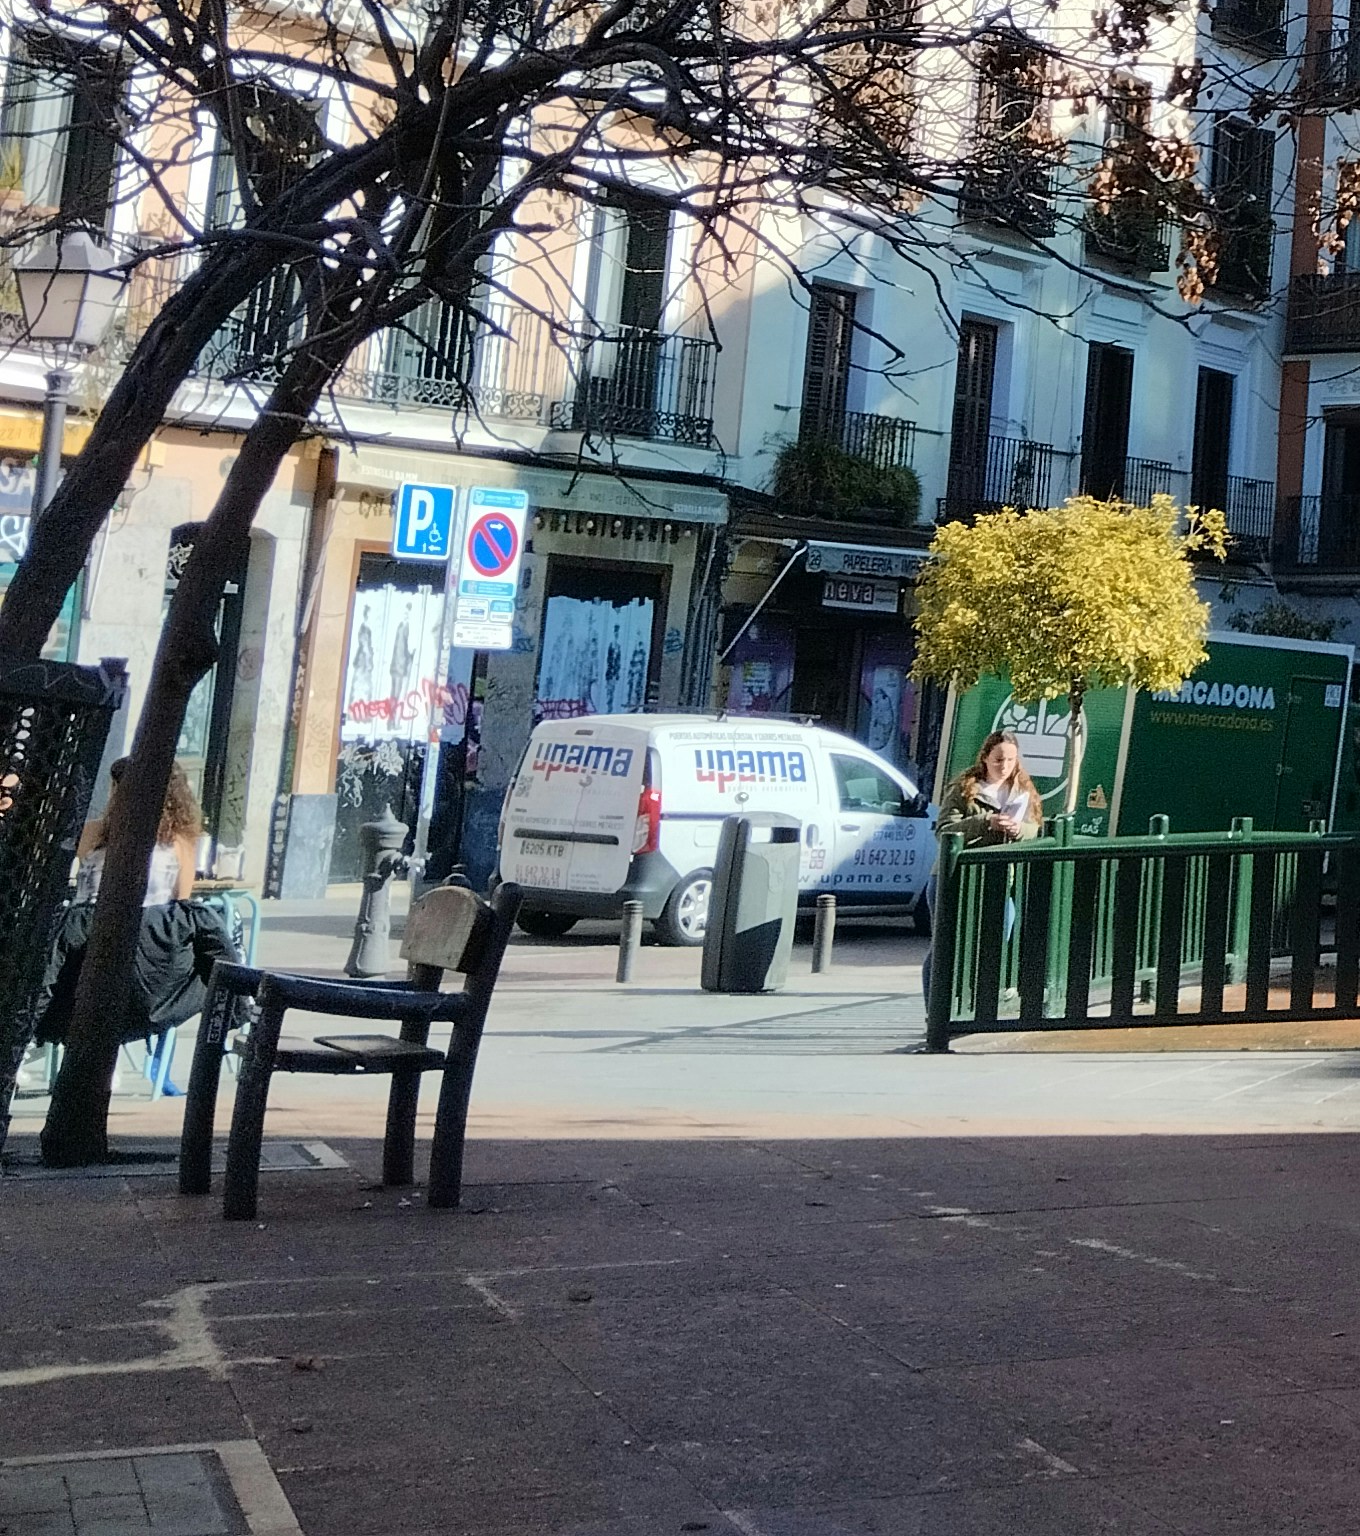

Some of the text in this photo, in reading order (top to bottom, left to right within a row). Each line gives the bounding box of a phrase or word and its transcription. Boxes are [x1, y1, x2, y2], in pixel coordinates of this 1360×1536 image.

[361, 465, 394, 479] ESTRELLA
[406, 488, 435, 547] P
[843, 554, 893, 572] PAPELERIA
[824, 581, 874, 602] neva
[1151, 710, 1274, 732] www.mercadona.es
[532, 742, 634, 782] upama
[694, 749, 807, 794] upama
[1081, 824, 1099, 834] GAS
[546, 845, 565, 857] KTB
[854, 848, 916, 866] 91 642 32 19
[798, 873, 912, 885] w.upama.es
